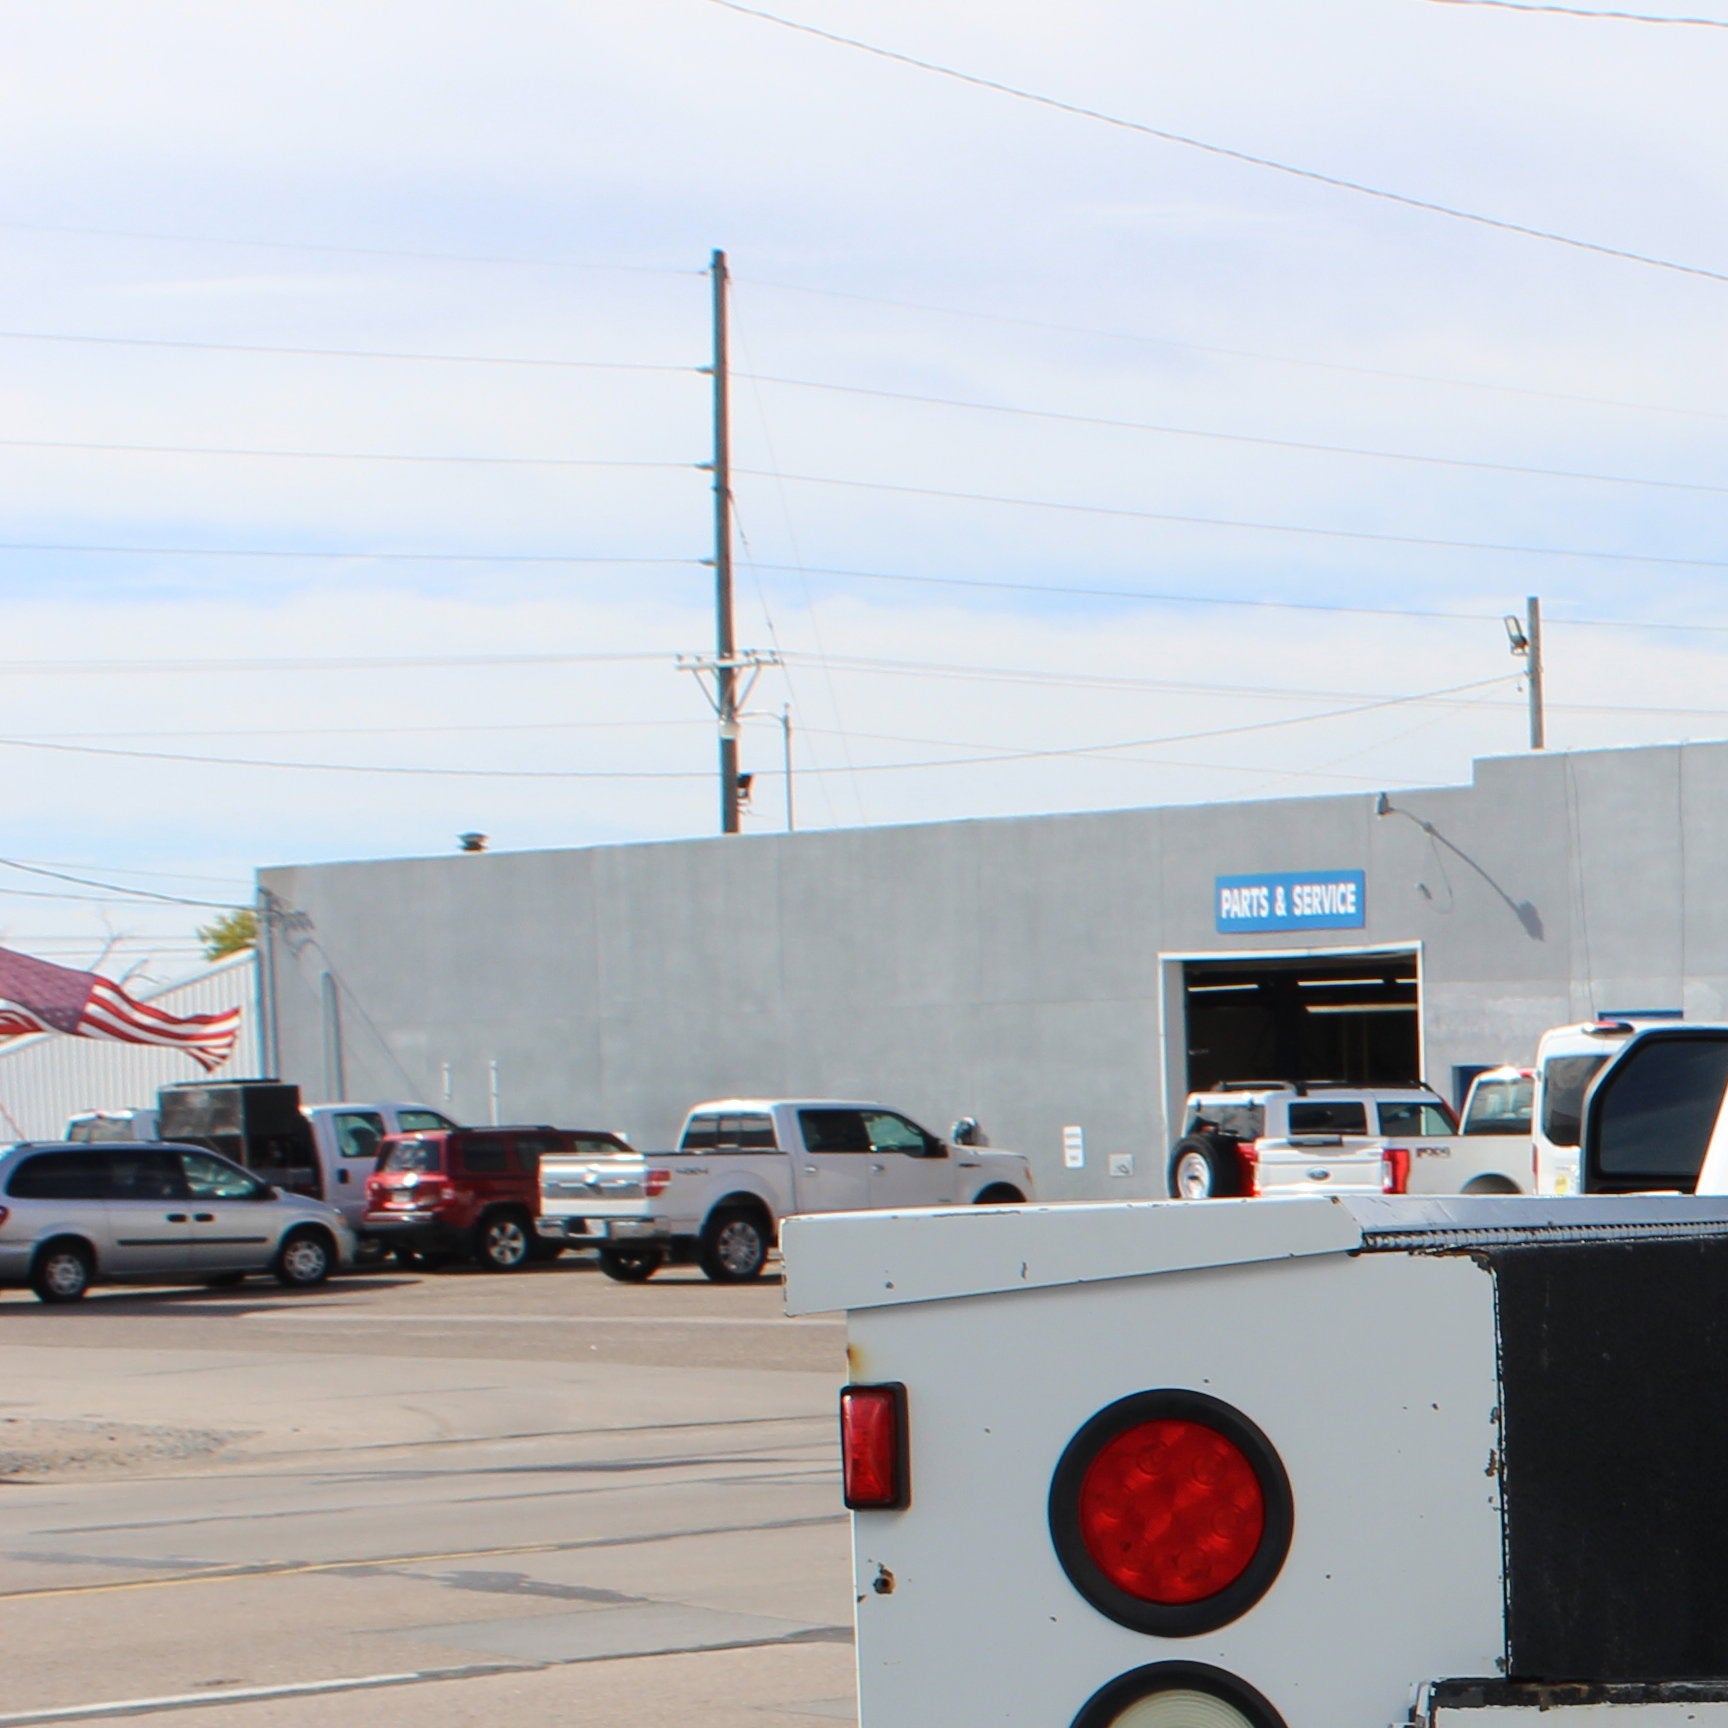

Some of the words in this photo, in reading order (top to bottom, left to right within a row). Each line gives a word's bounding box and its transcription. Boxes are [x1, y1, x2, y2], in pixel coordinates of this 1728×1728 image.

[1220, 886, 1269, 919] PARTS
[1274, 886, 1287, 917] &
[1292, 883, 1357, 917] SERVICE
